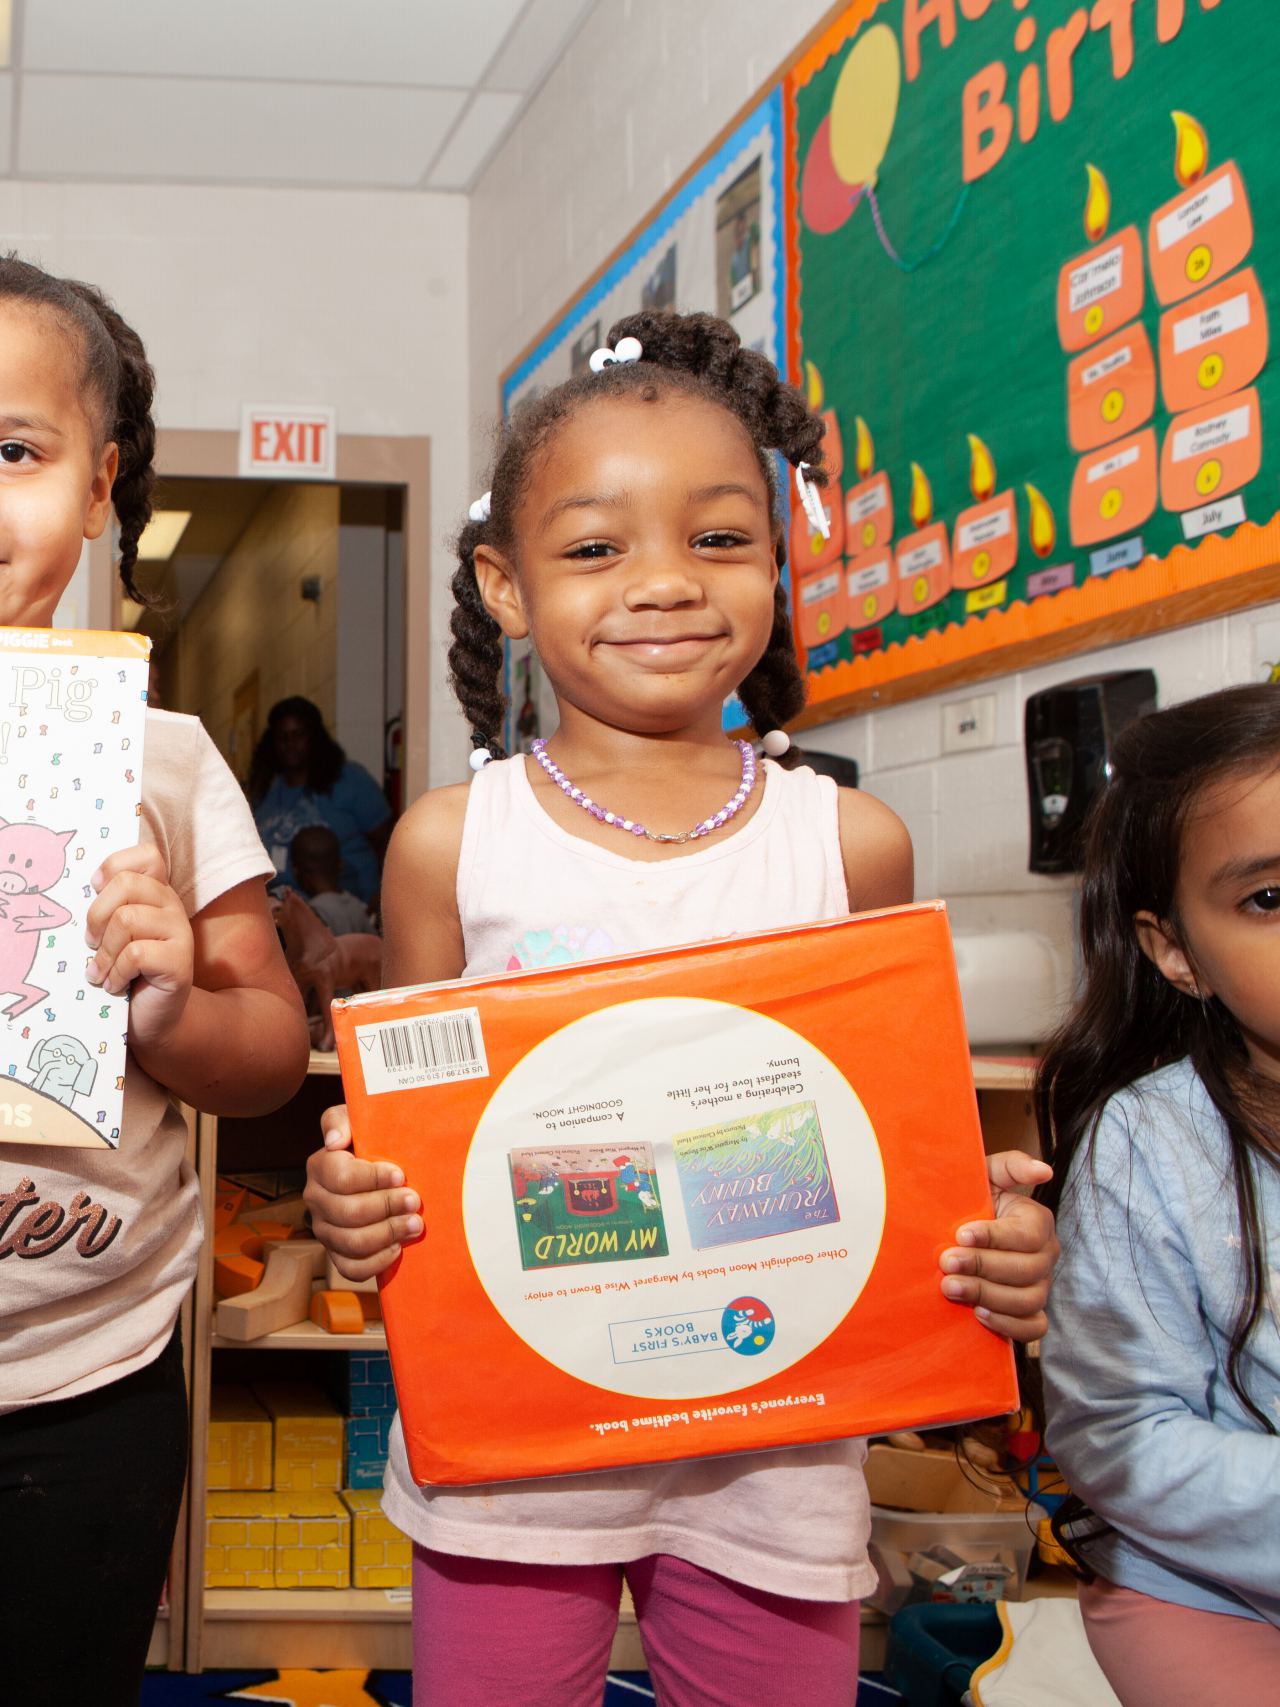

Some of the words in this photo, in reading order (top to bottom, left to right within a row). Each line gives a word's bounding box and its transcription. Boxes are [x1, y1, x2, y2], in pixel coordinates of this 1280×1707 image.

[252, 420, 327, 463] EXIT
[9, 666, 99, 722] Pig
[472, 1065, 482, 1073] US
[766, 1057, 800, 1069] bunny.
[446, 1067, 470, 1077] $17.99
[756, 1071, 802, 1086] steadfast
[398, 1076, 414, 1085] CAN
[715, 1081, 729, 1093] for
[732, 1078, 753, 1089] love
[667, 1088, 690, 1100] little
[694, 1085, 710, 1096] her
[736, 1093, 742, 1101] a
[746, 1083, 804, 1100] Celebrating
[567, 1099, 623, 1115] GOODNIGHT
[691, 1095, 733, 1110] mother's
[533, 1108, 564, 1119] MOON.
[616, 1112, 624, 1120] A
[545, 1122, 556, 1131] to
[559, 1114, 613, 1129] companion
[690, 1170, 775, 1207] BUNNY
[706, 1185, 823, 1228] RUNAWAY
[804, 1208, 829, 1220] The
[534, 1230, 619, 1260] WORLD
[625, 1226, 658, 1254] MY
[817, 1248, 848, 1260] Other
[729, 1261, 757, 1272] Moon
[760, 1254, 814, 1270] Goodnight
[633, 1273, 679, 1286] Margaret
[682, 1271, 694, 1281] by
[696, 1267, 726, 1279] books
[570, 1284, 602, 1296] Brown
[604, 1281, 630, 1292] Wise
[523, 1289, 553, 1302] enjoy:
[556, 1289, 568, 1298] to
[644, 1322, 694, 1338] BOOKS
[631, 1339, 667, 1353] FIRST
[671, 1332, 718, 1347] BABY'S
[751, 1393, 826, 1414] Everyone's
[692, 1403, 748, 1421] favorite
[632, 1411, 689, 1429] bedtime
[589, 1419, 629, 1435] book.
